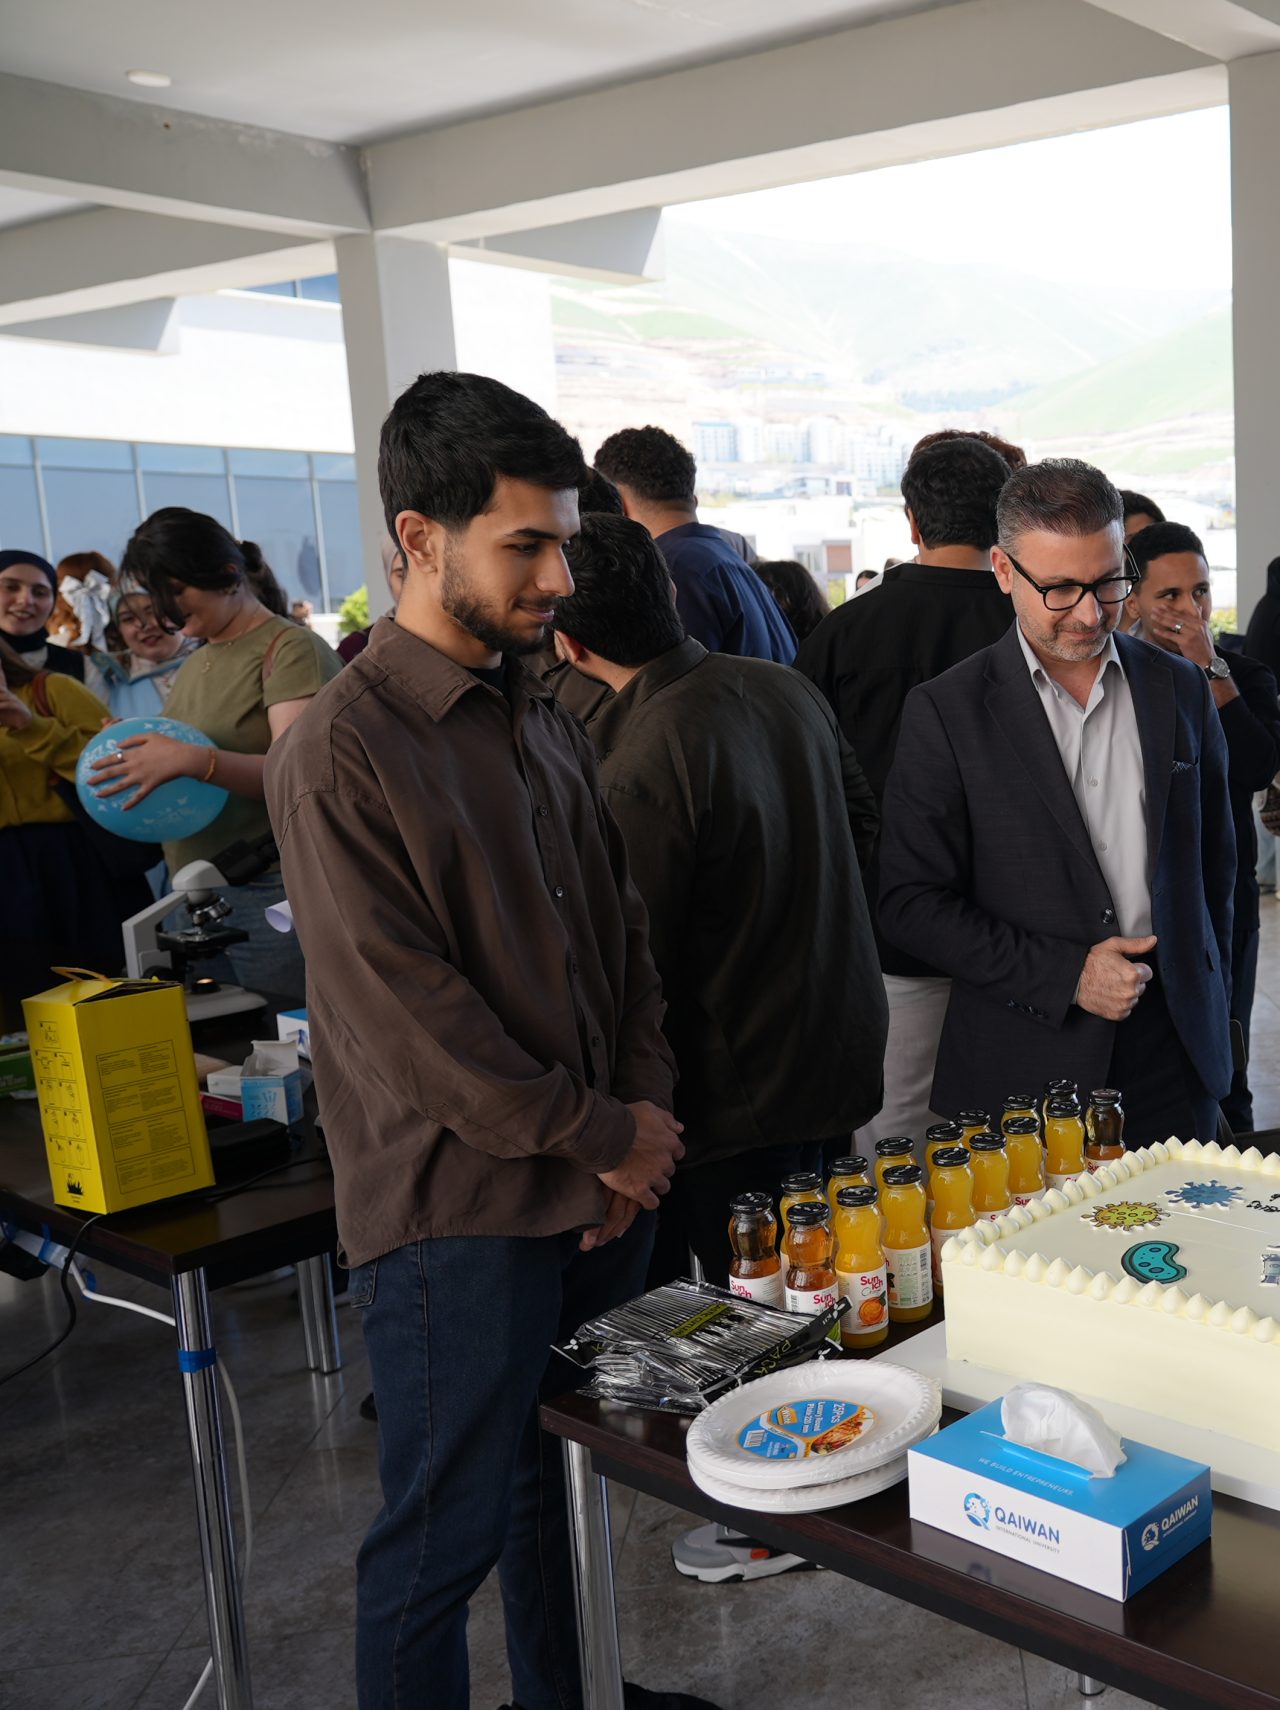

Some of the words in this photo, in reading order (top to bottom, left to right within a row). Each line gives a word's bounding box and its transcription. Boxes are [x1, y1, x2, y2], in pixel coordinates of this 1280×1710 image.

[730, 1280, 746, 1293] Sun
[860, 1275, 879, 1287] Sun
[813, 1292, 832, 1305] Sun
[753, 1339, 791, 1375] PACK
[990, 1462, 1013, 1474] BUILD
[1161, 1495, 1199, 1531] QAIWAN
[995, 1506, 1060, 1545] QAIWAN
